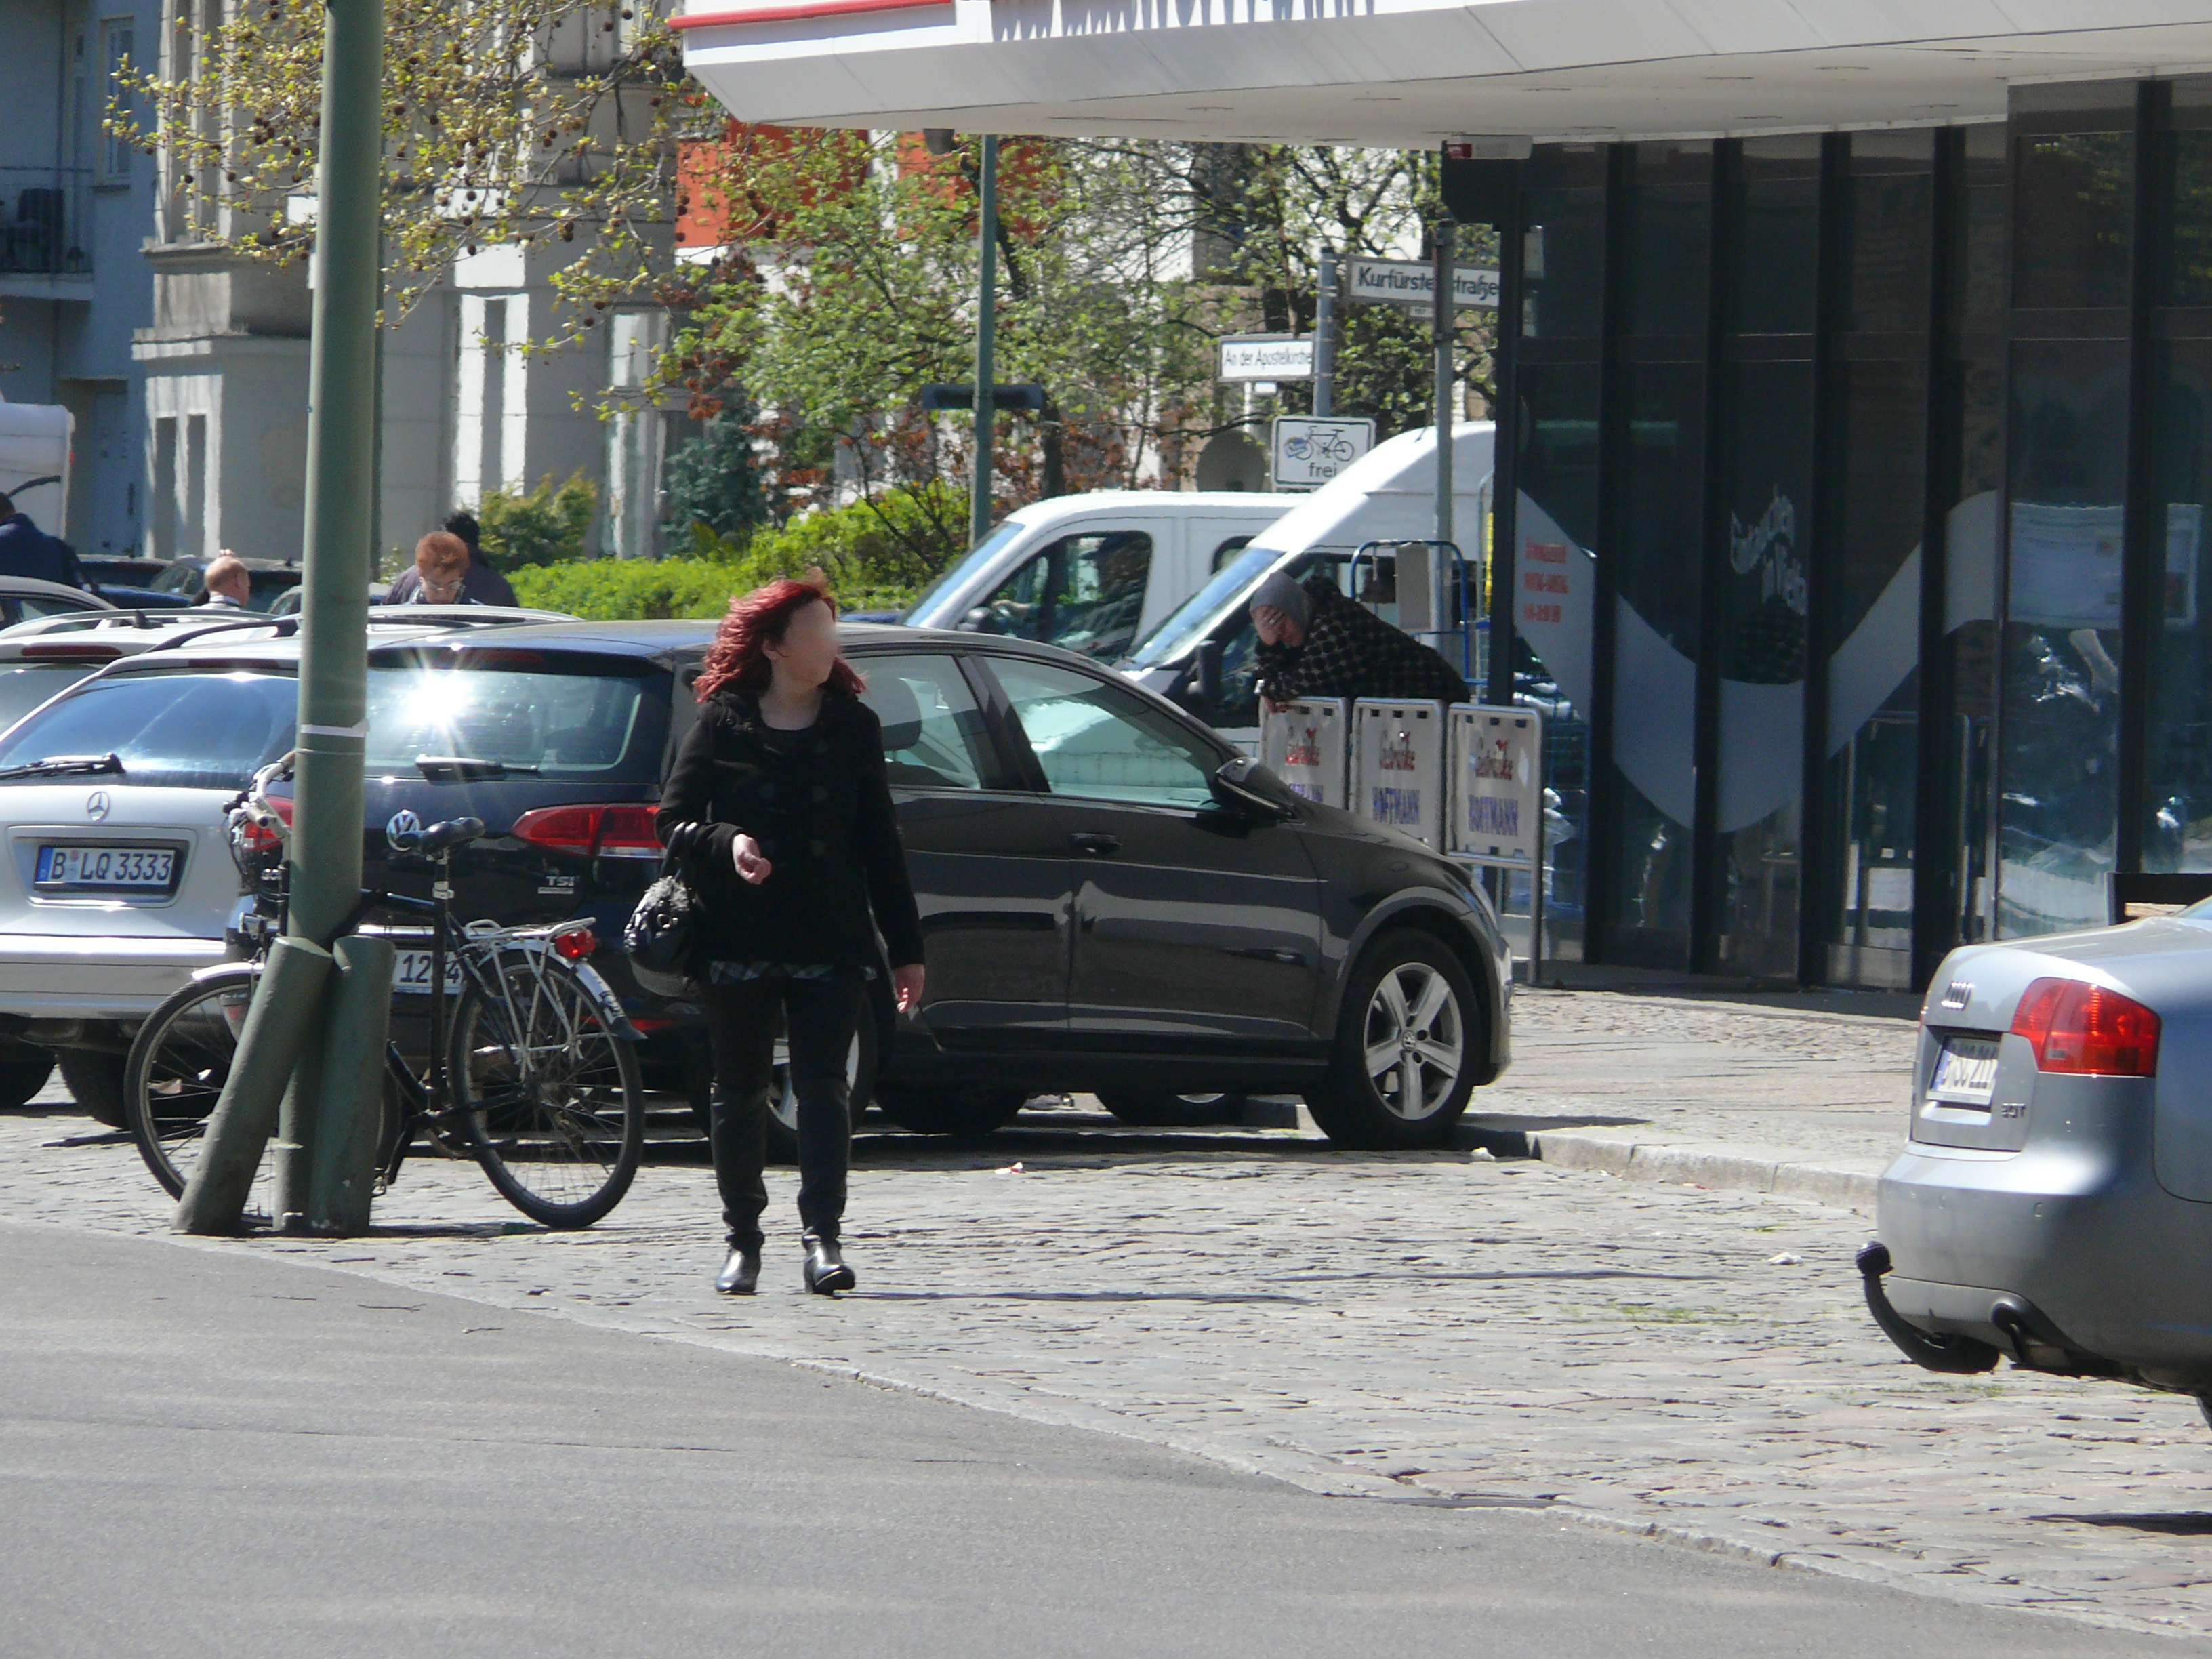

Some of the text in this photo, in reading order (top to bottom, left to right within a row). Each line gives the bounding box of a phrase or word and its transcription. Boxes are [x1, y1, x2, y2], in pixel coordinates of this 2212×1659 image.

[1359, 266, 1499, 300] Kurfürstetraße
[1224, 348, 1237, 366] An
[1240, 348, 1253, 366] der
[1309, 462, 1337, 478] frei
[51, 852, 171, 881] B LQ 3333
[546, 876, 576, 886] TSI
[400, 954, 460, 984] 124
